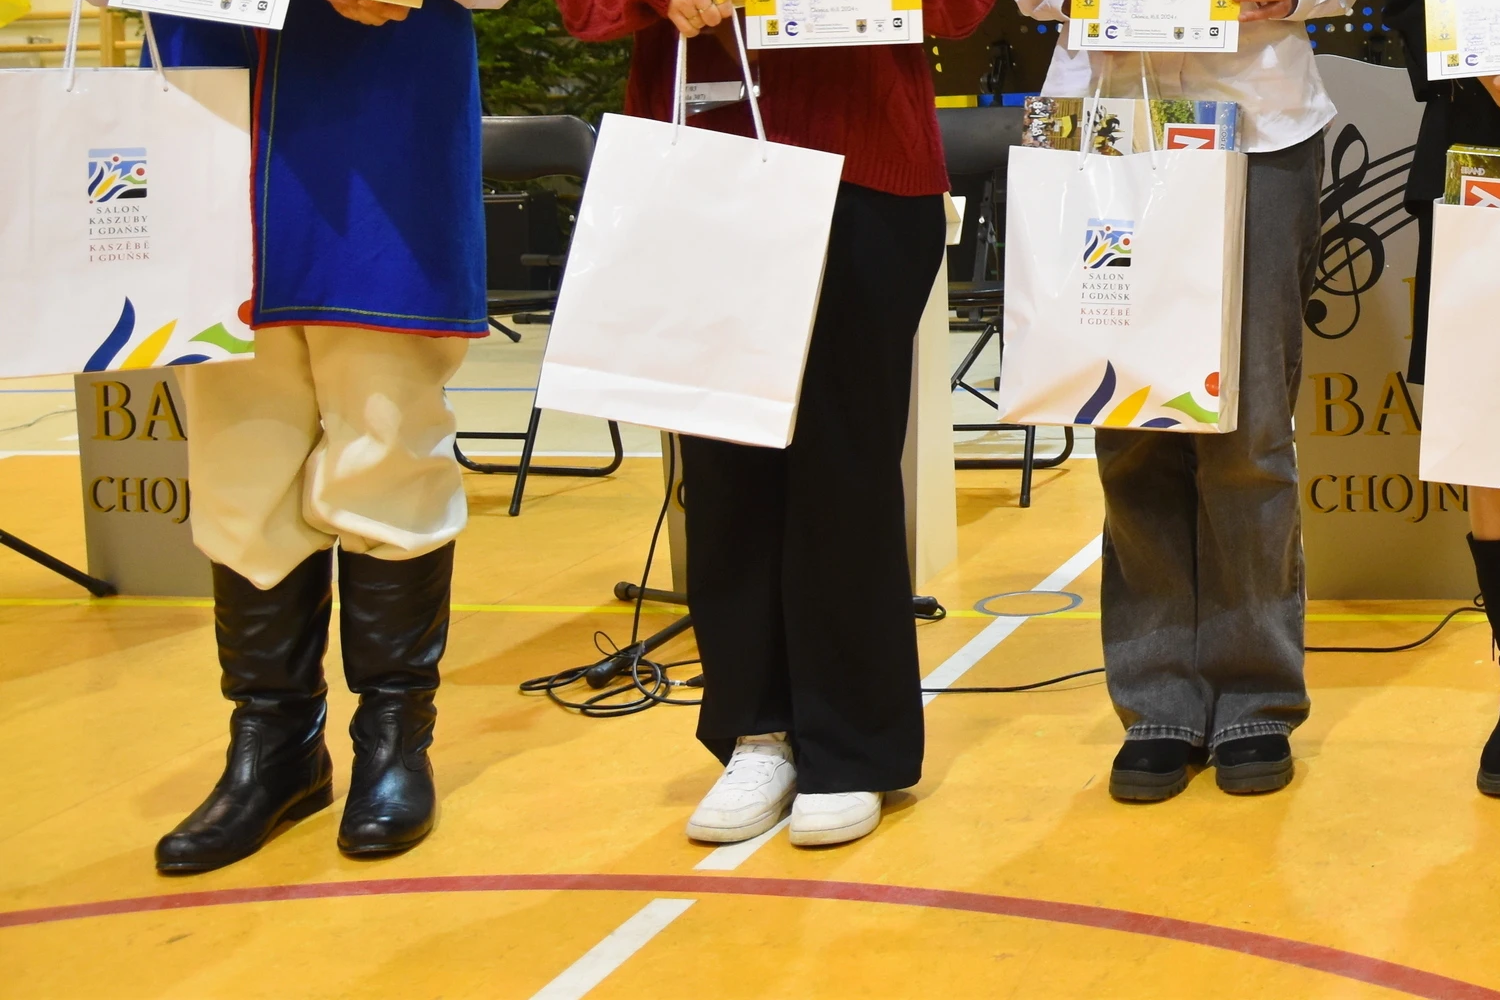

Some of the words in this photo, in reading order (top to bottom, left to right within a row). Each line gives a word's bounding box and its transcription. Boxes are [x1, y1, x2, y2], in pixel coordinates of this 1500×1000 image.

[96, 205, 140, 214] SALON
[89, 216, 149, 225] KASZUBY
[98, 225, 149, 236] GDAŃSK
[1089, 273, 1125, 281] SALON
[1082, 282, 1131, 291] KASZUBY
[1089, 291, 1131, 301] GDAŃSK
[1308, 371, 1423, 437] BA
[90, 381, 188, 441] BA
[88, 476, 190, 524] CHOJ
[1306, 474, 1468, 523] CHOJN
